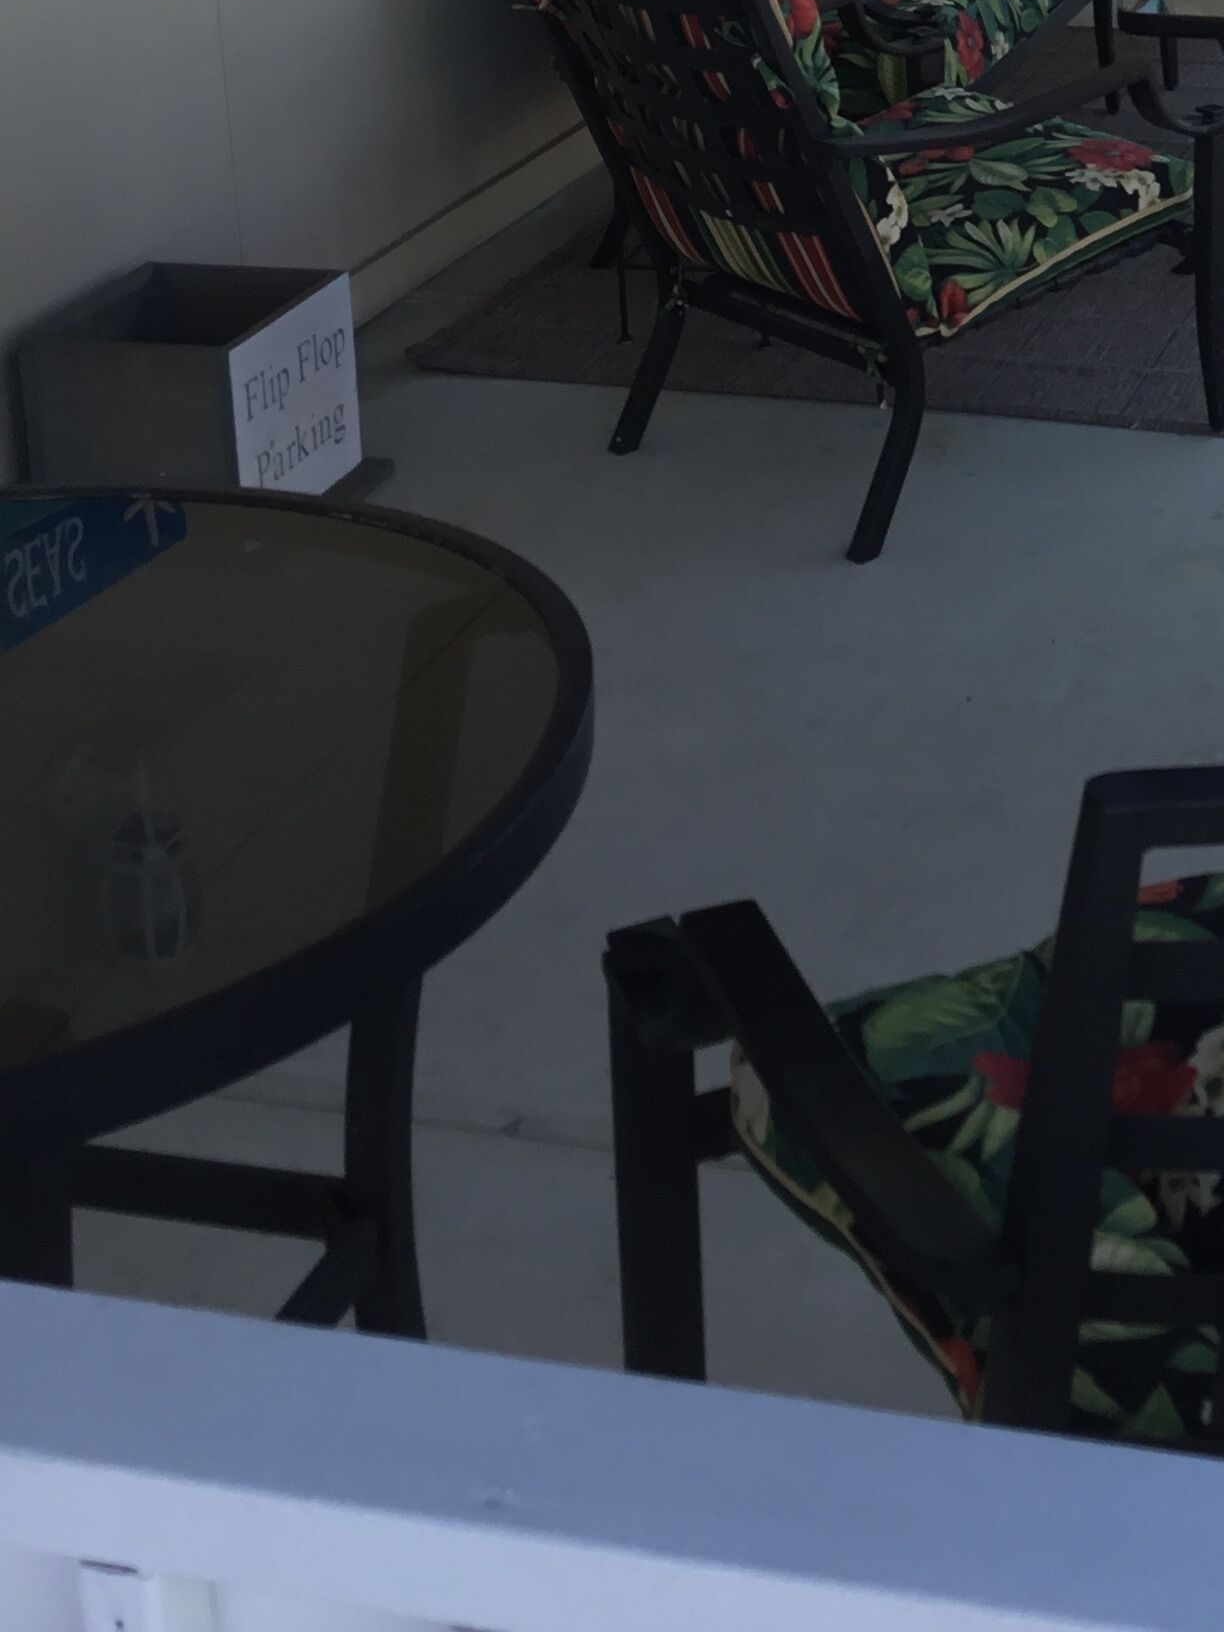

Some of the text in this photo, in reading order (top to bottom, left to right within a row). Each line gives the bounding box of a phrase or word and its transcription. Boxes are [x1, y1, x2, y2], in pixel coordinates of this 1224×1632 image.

[242, 327, 346, 423] Flip Flop
[256, 402, 347, 488] Parking
